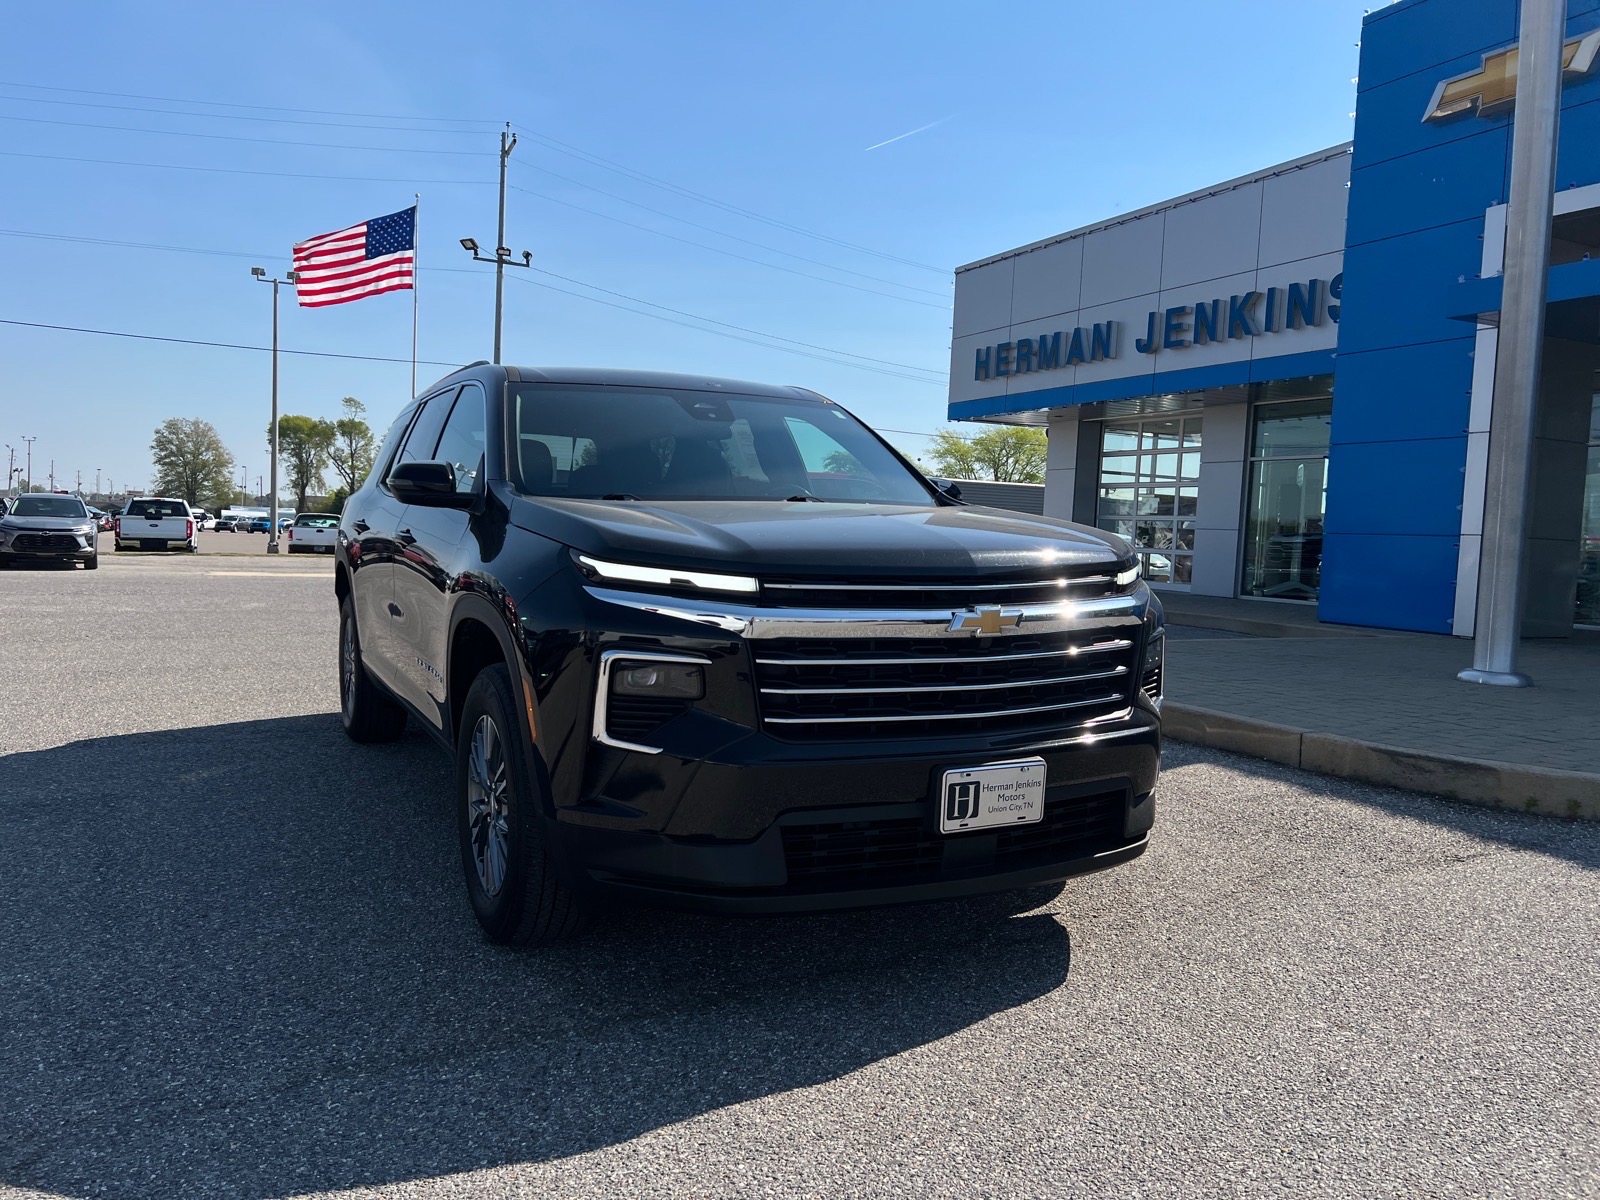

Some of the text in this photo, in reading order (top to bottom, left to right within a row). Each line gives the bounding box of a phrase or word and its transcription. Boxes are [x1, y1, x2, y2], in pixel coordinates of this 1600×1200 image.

[974, 320, 1119, 381] HERMAN
[982, 780, 1042, 792] Herman Jenkins
[997, 793, 1026, 802] Motors
[988, 803, 1008, 813] Union
